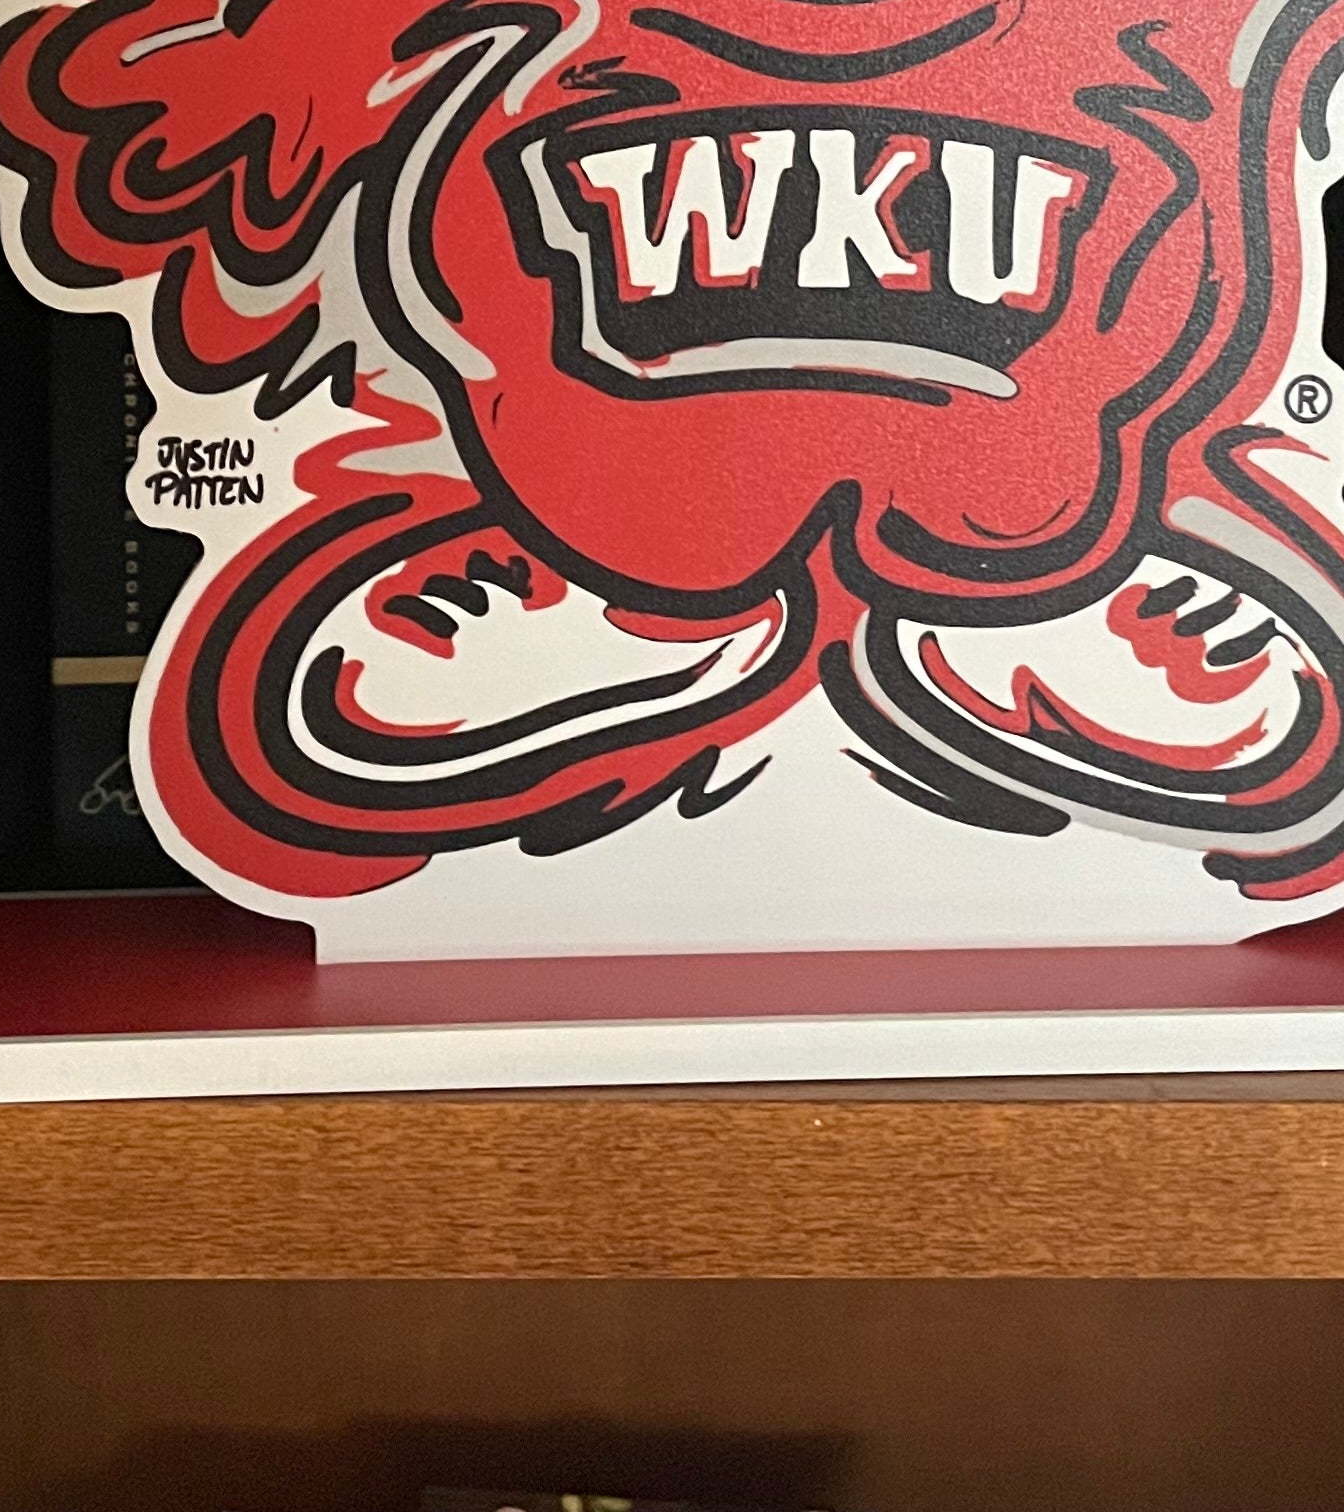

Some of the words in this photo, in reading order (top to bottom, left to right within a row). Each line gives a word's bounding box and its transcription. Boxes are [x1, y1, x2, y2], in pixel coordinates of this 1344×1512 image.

[566, 128, 1089, 312] WKU
[157, 436, 255, 473] JUSTIN
[144, 470, 264, 510] PATTEN
